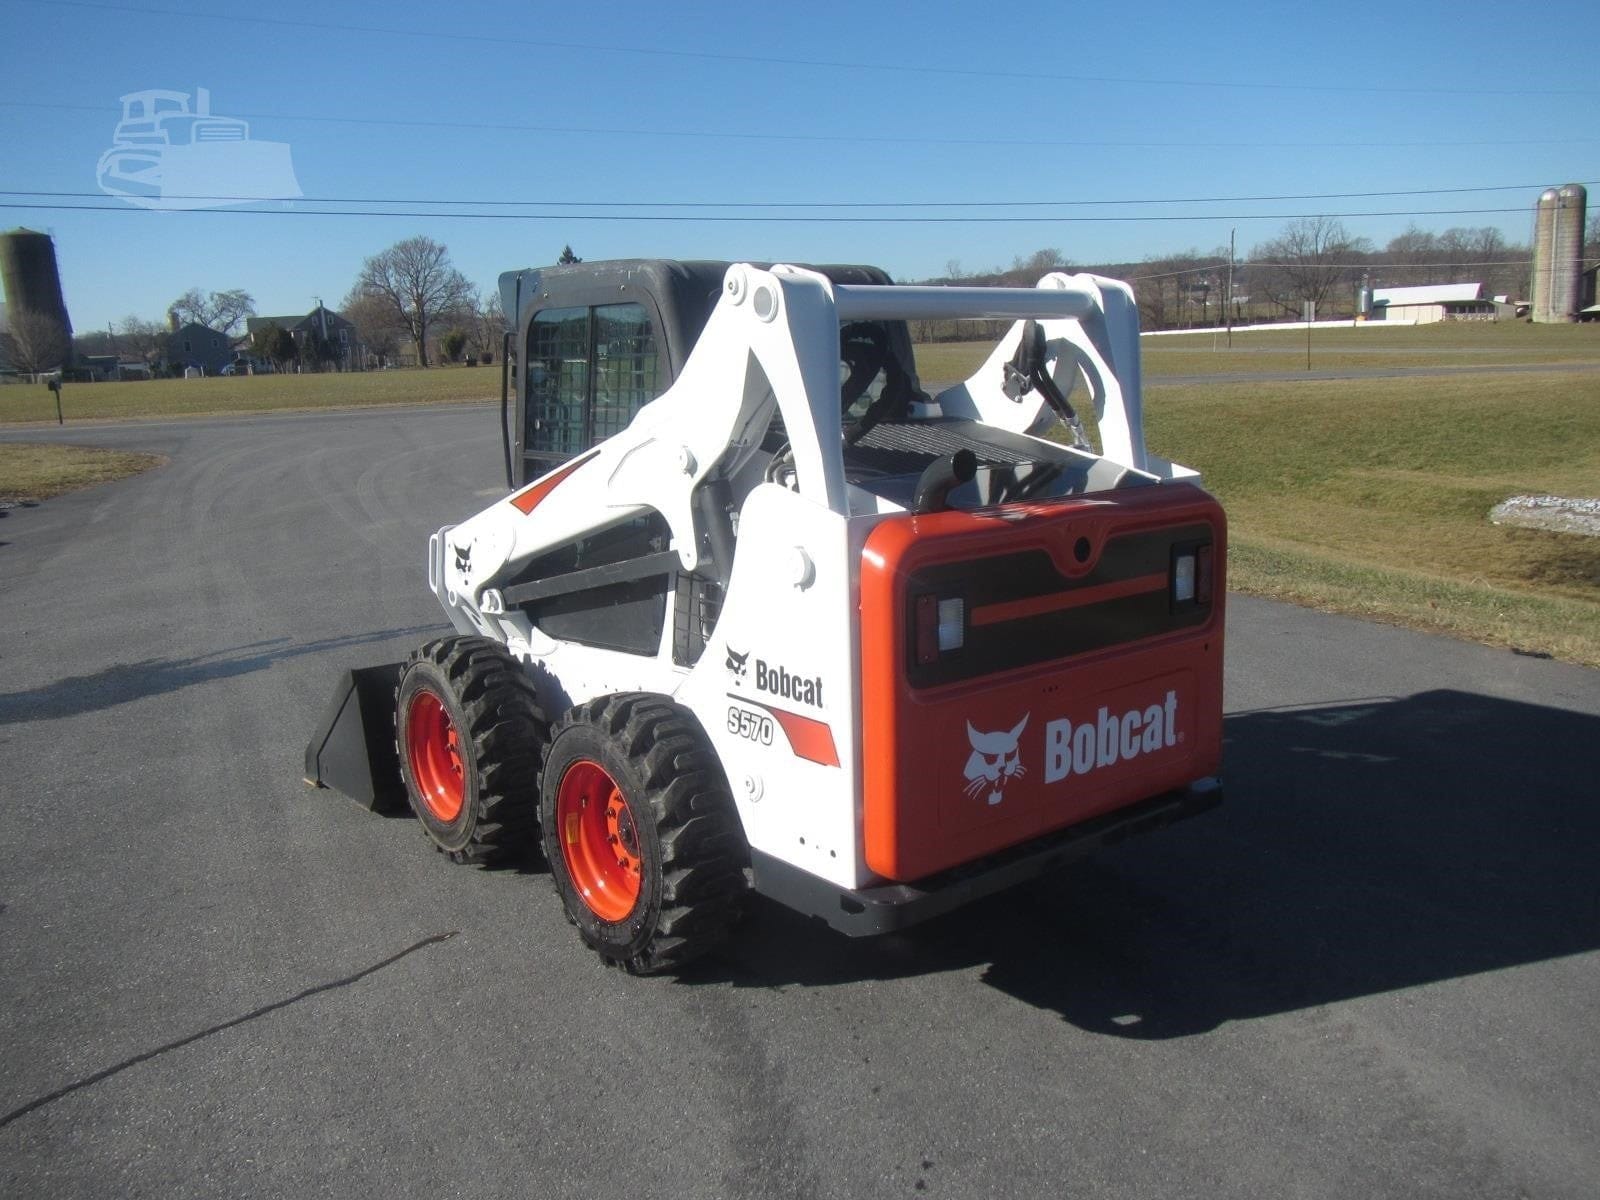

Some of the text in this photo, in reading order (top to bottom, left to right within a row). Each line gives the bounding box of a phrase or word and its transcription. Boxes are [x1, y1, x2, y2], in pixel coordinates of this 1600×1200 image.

[755, 658, 823, 709] Bobcat
[727, 705, 774, 746] S570
[1044, 690, 1179, 784] Bobcat
